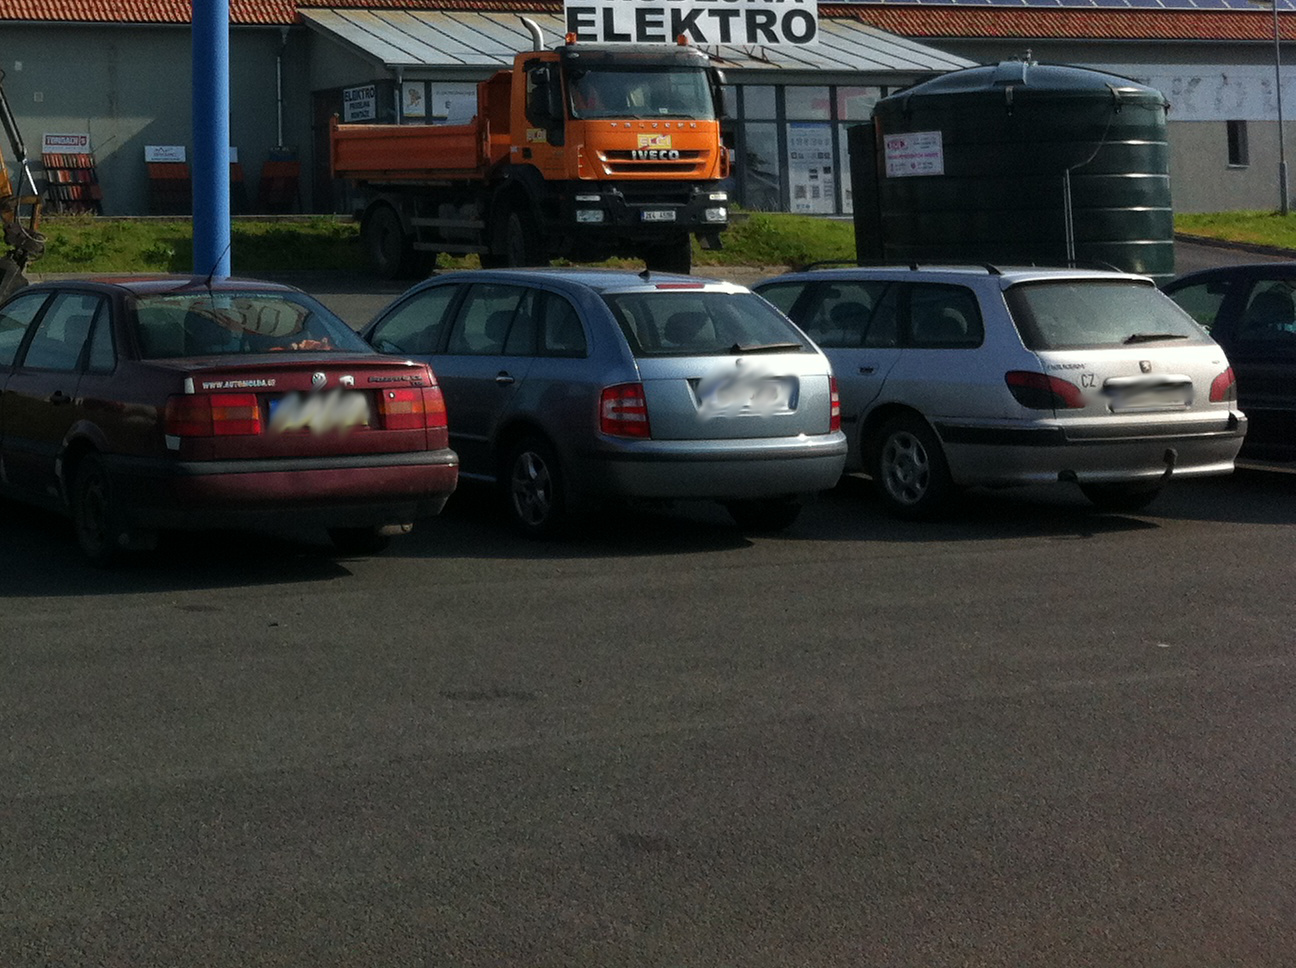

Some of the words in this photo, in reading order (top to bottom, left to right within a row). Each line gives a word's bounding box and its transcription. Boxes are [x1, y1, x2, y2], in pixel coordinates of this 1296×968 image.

[566, 6, 816, 44] ELEKTRO
[631, 150, 680, 160] IVECO
[1081, 373, 1096, 388] CZ
